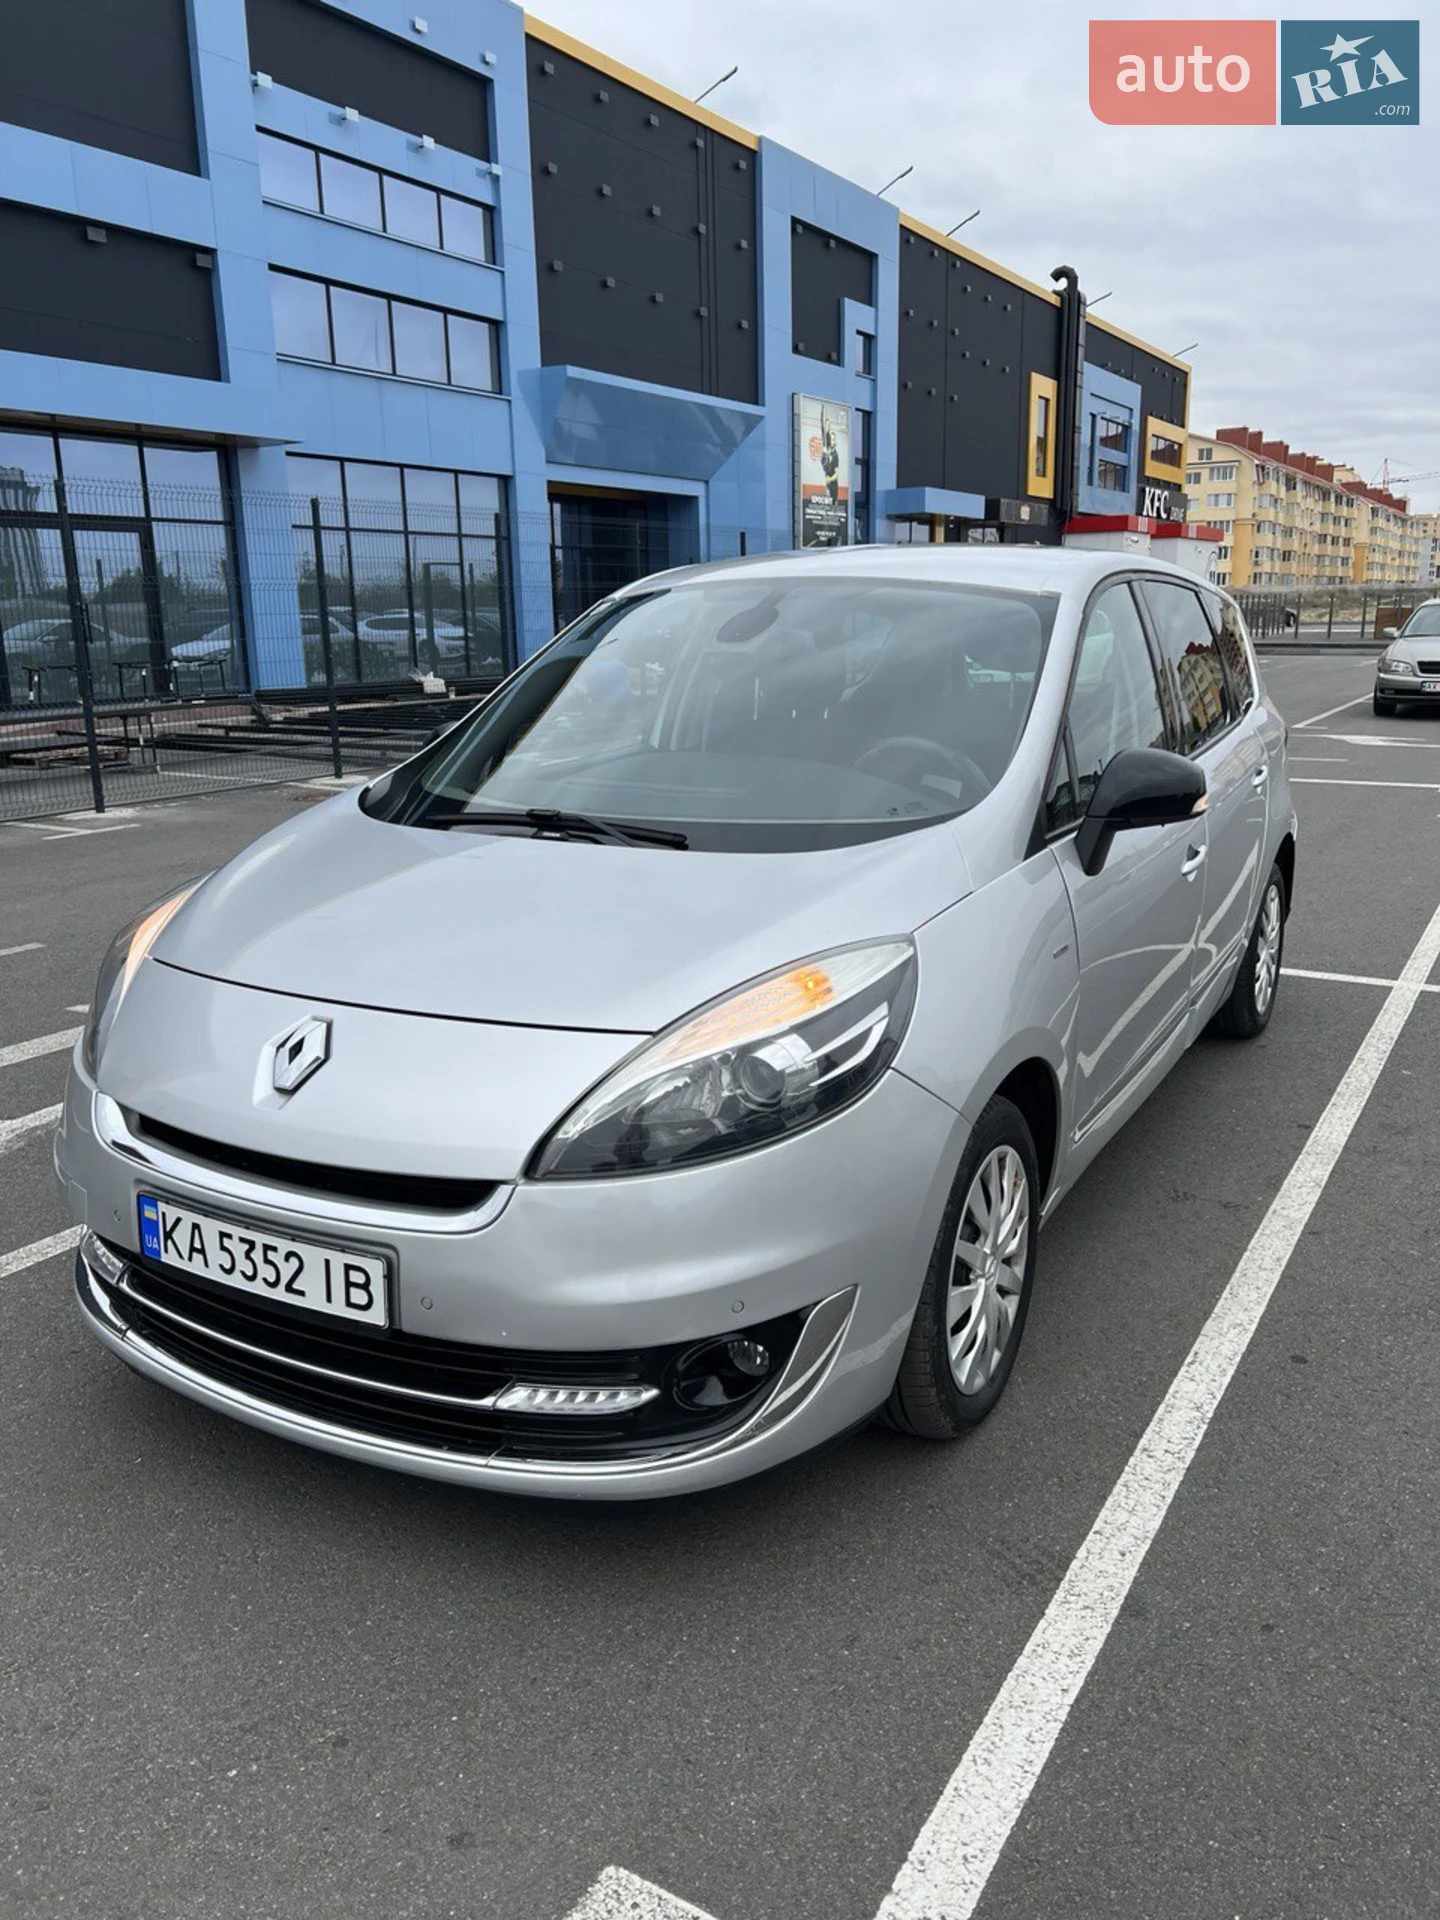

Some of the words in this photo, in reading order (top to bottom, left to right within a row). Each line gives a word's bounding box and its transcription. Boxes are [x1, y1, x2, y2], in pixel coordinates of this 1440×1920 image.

[1142, 486, 1170, 519] KFC
[145, 1236, 158, 1250] UA
[161, 1210, 209, 1268] KA
[218, 1230, 306, 1297] 5352
[324, 1258, 374, 1312] IB
